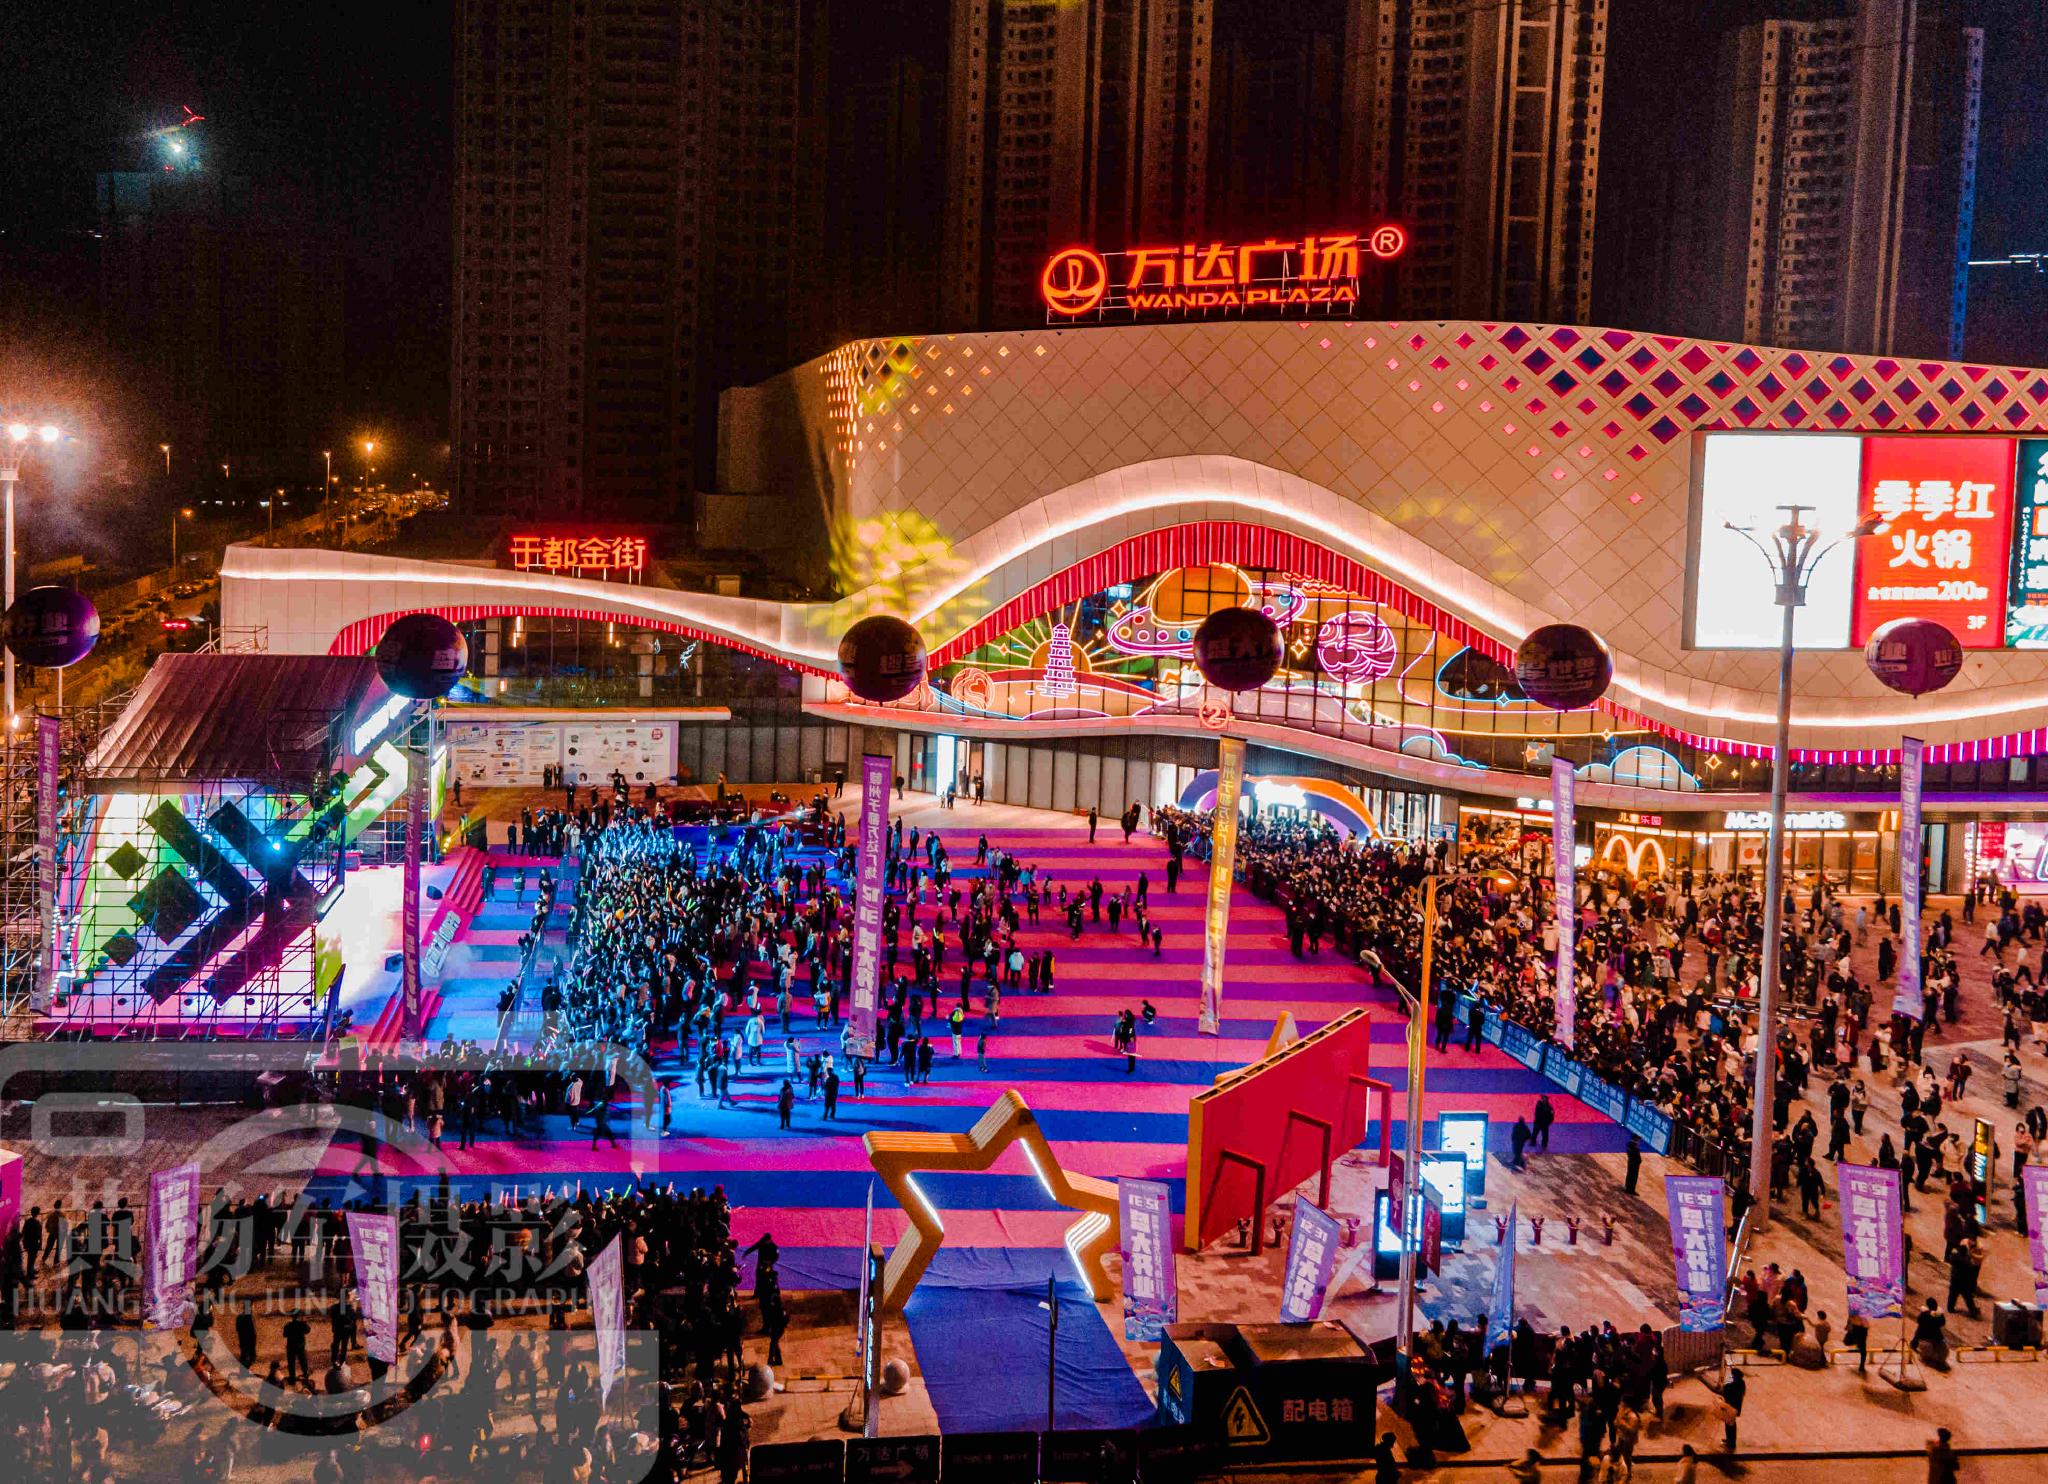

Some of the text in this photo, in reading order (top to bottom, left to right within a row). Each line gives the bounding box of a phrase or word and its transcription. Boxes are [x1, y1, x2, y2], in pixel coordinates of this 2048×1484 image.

[1126, 235, 1359, 288] 万达广场
[1126, 286, 1356, 309] WANDA PLAZA
[1873, 480, 1995, 522] 季季红
[511, 536, 646, 569] 于都金街
[1888, 529, 1972, 569] 火锅
[1967, 615, 1988, 630] 3F
[1723, 811, 1846, 829] McDnald's
[1283, 1400, 1354, 1423] 配电箱
